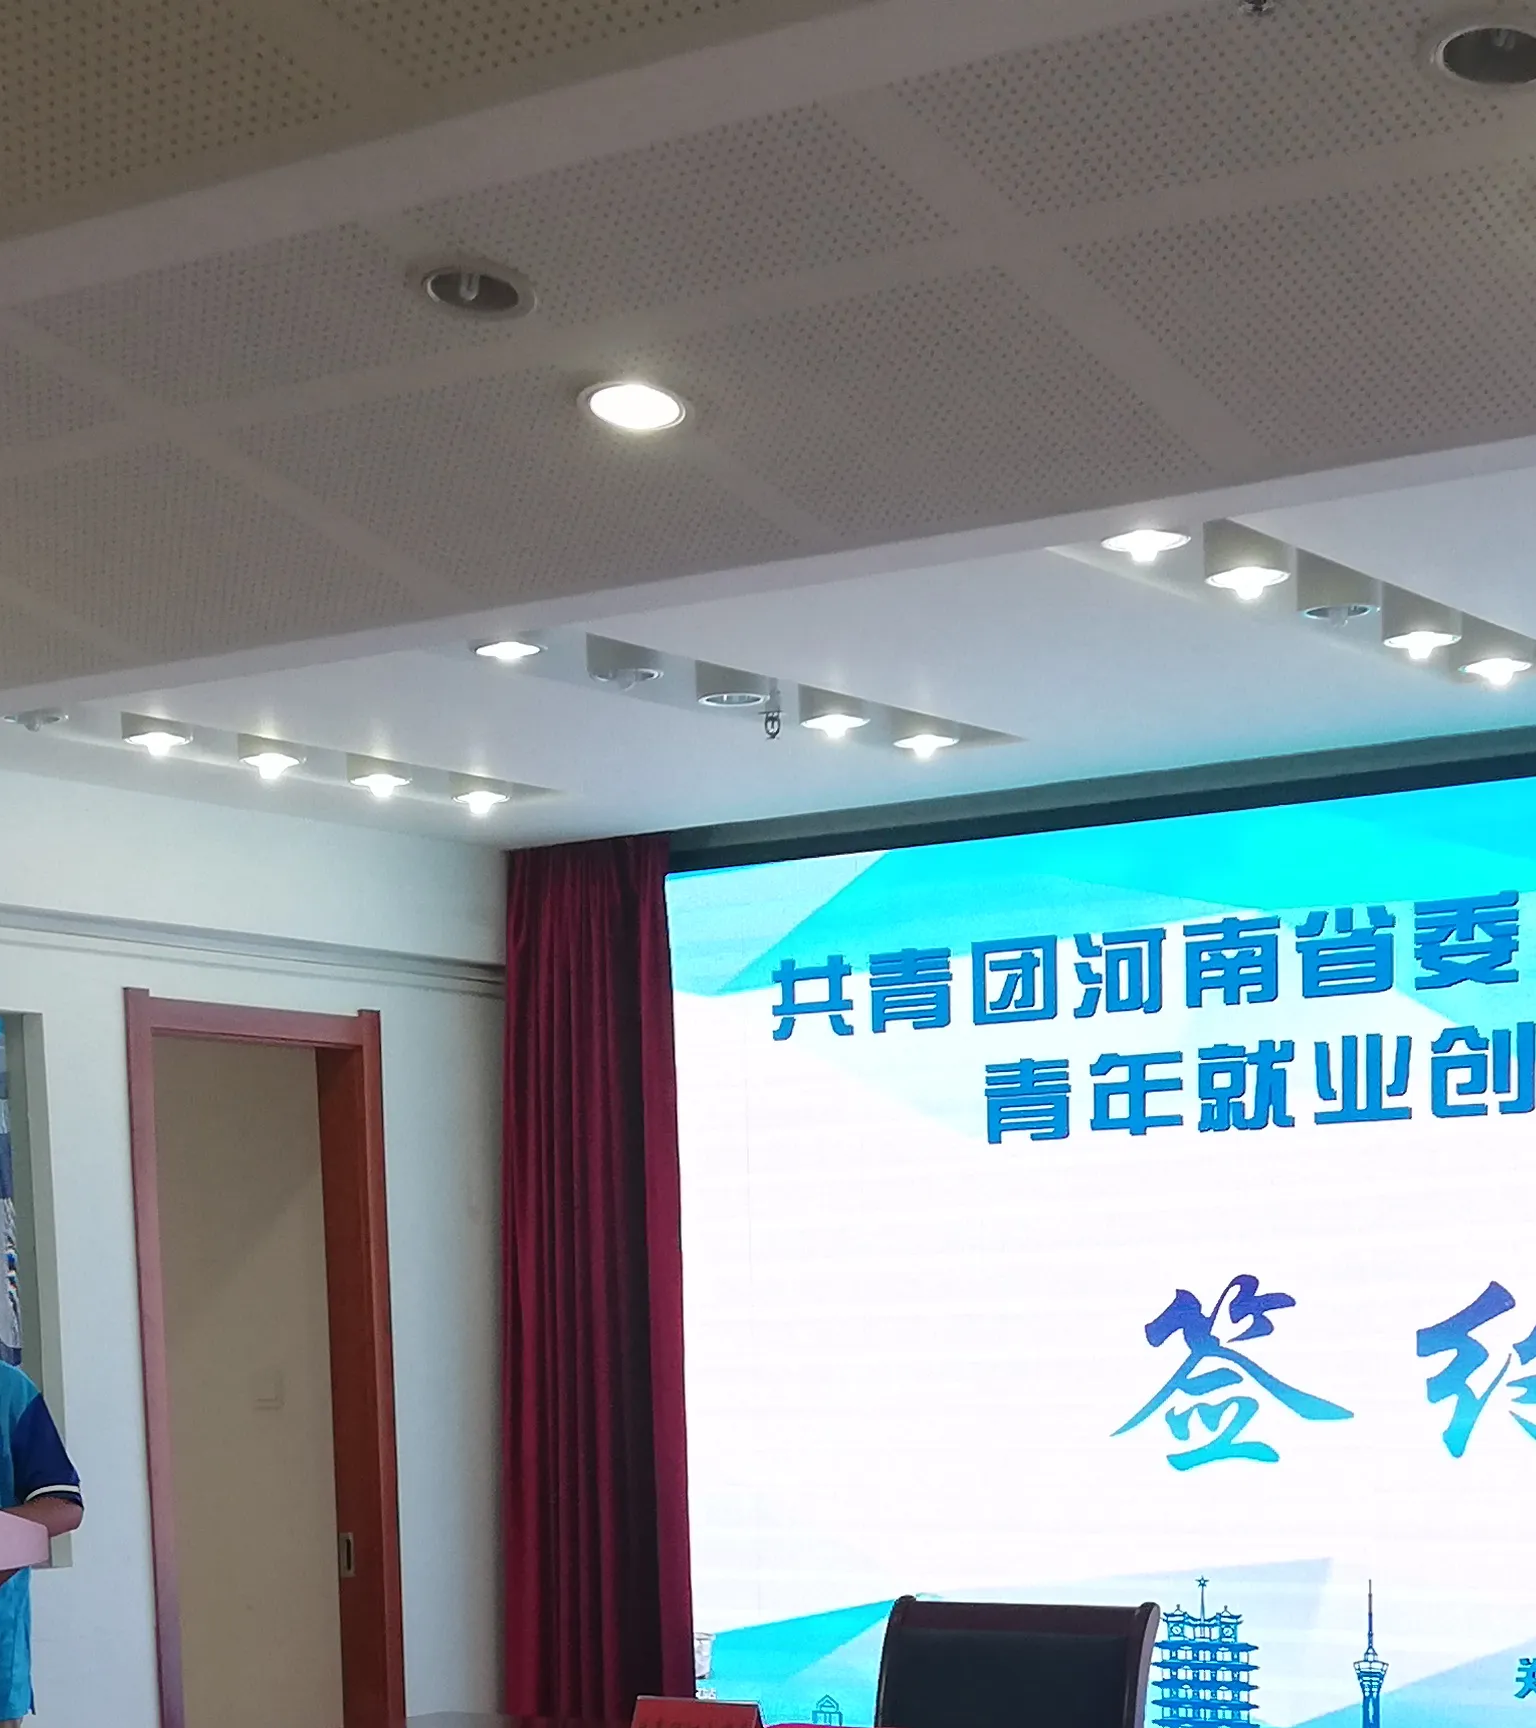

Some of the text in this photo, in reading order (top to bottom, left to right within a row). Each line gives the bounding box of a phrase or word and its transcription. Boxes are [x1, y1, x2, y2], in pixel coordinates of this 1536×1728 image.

[771, 889, 1520, 1040] 共青团河南省委
